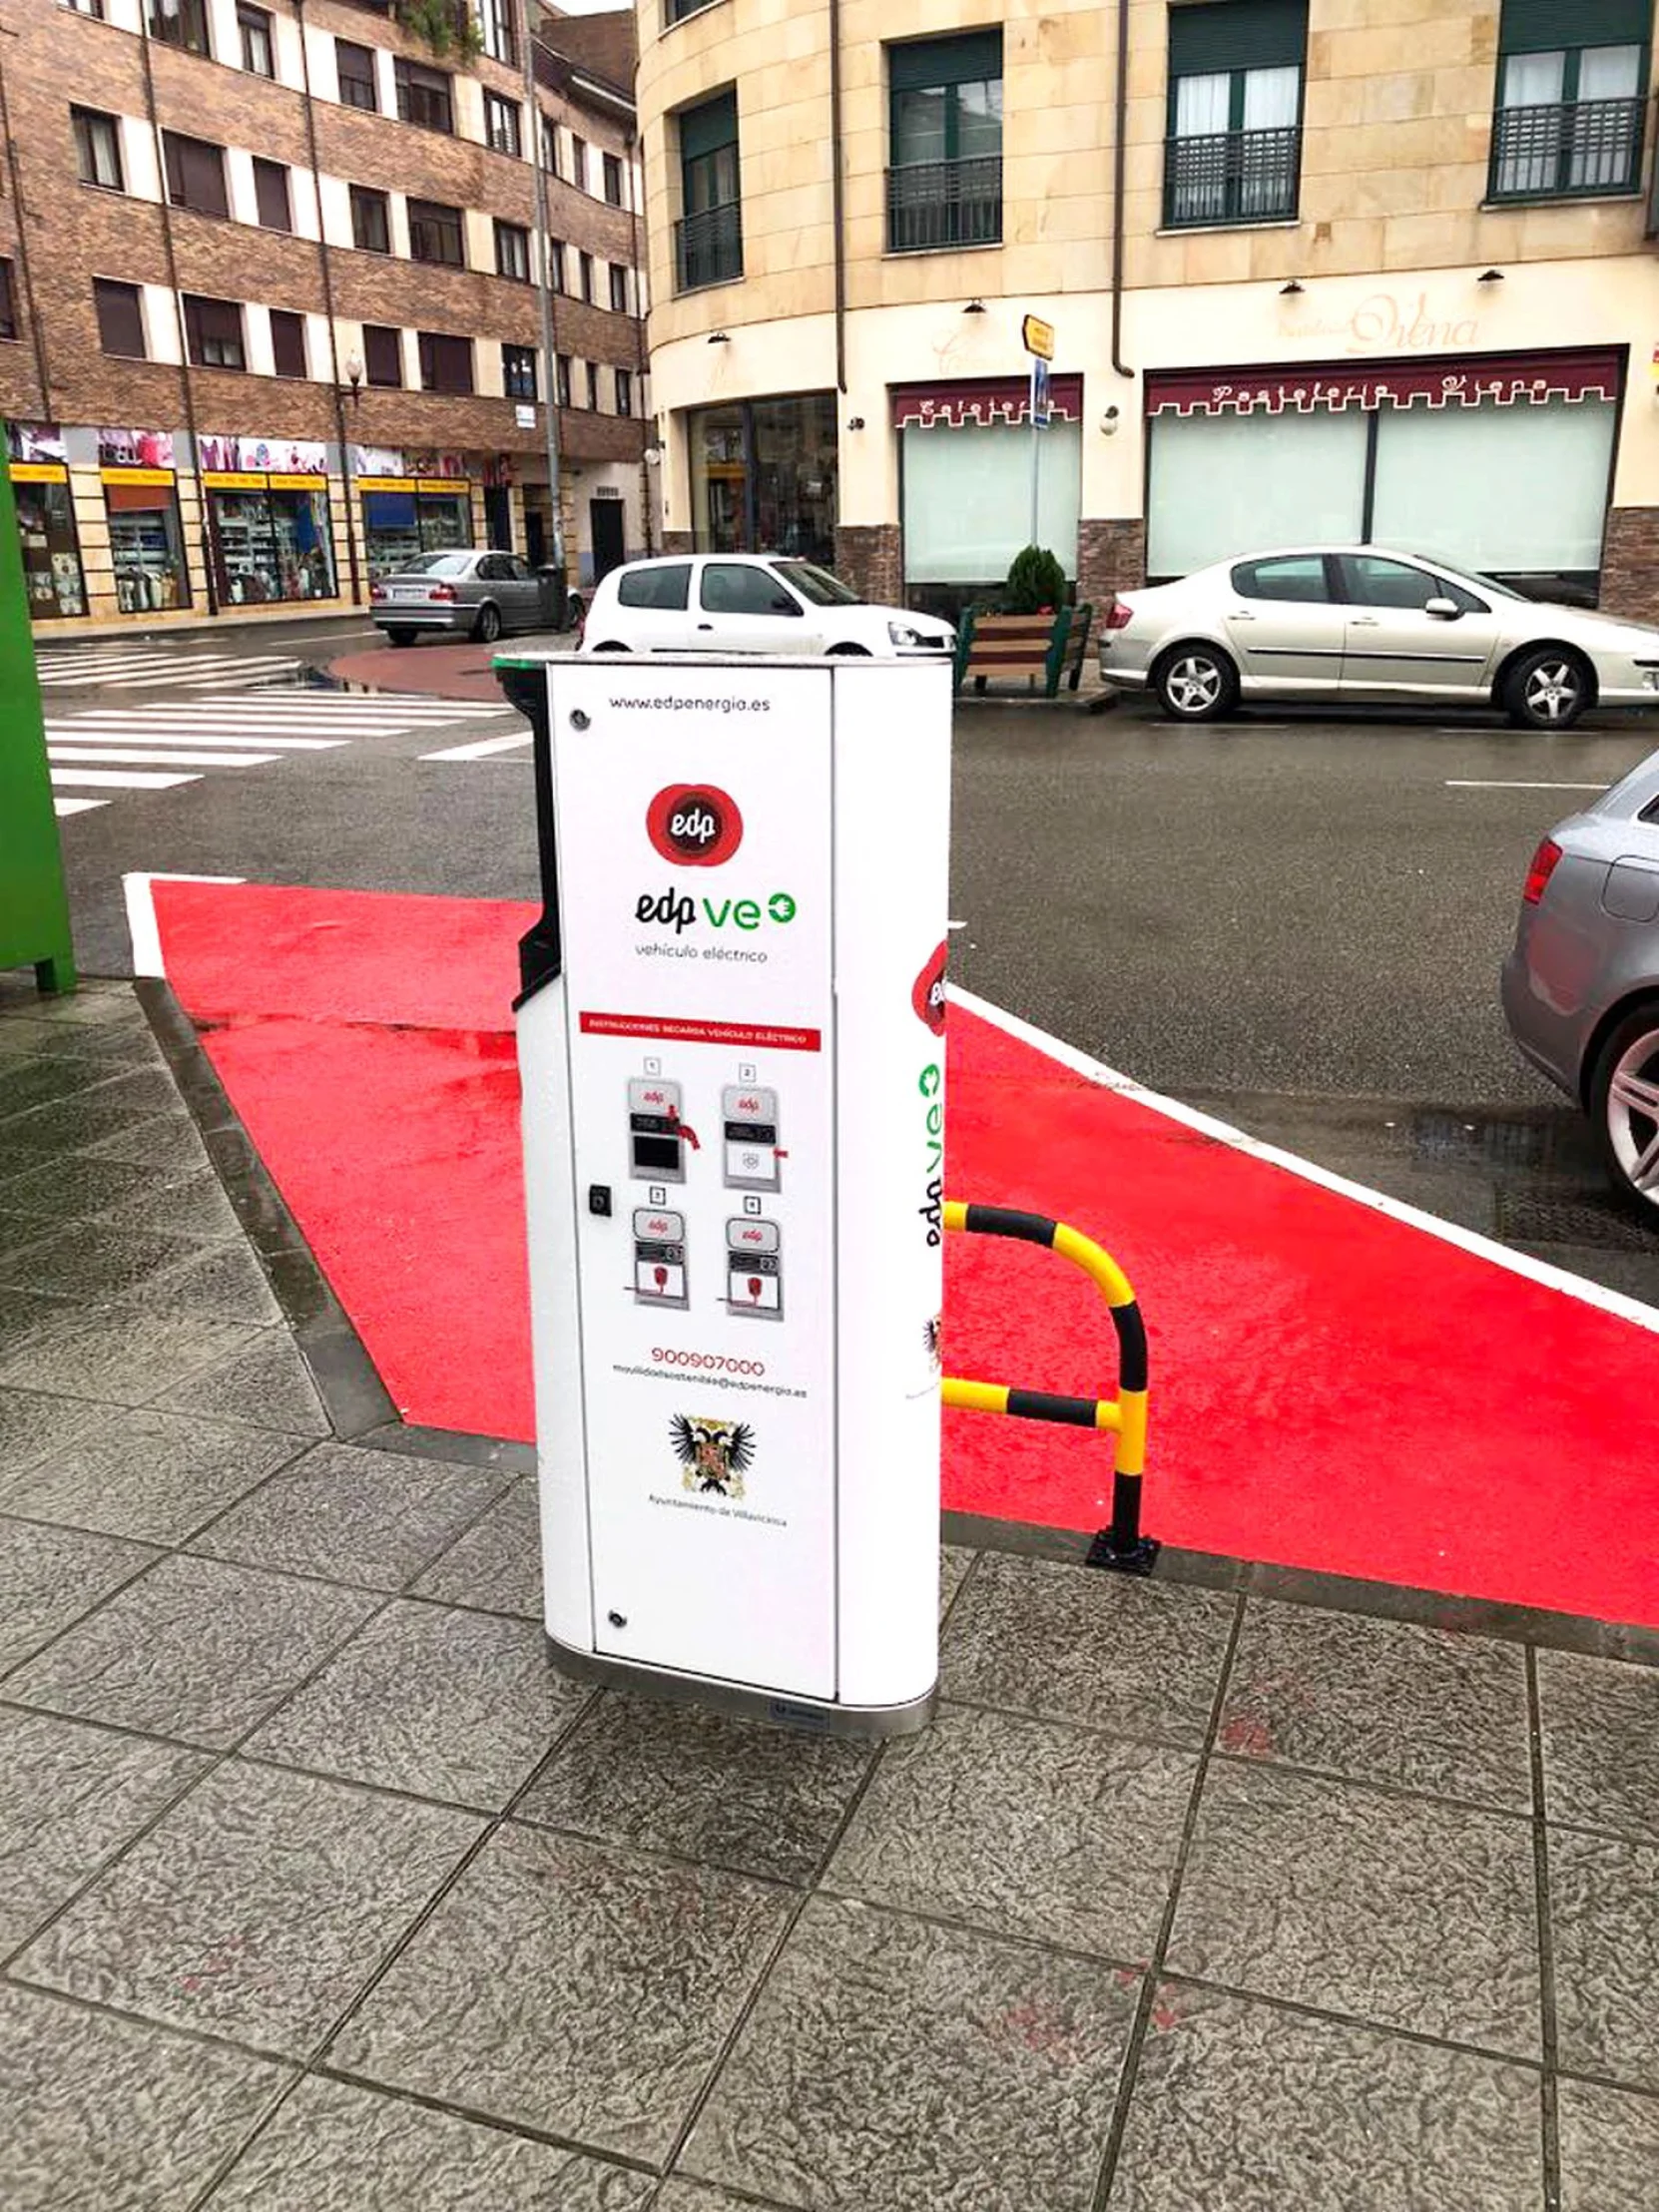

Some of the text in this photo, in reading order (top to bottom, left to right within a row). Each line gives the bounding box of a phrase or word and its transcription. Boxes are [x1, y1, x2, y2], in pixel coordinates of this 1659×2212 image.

[609, 695, 772, 714] www.edpenergia.es
[670, 808, 716, 844] edp
[635, 886, 762, 935] edp ve
[635, 943, 769, 964] vehículo eléctrico
[652, 1348, 766, 1377] 900907000
